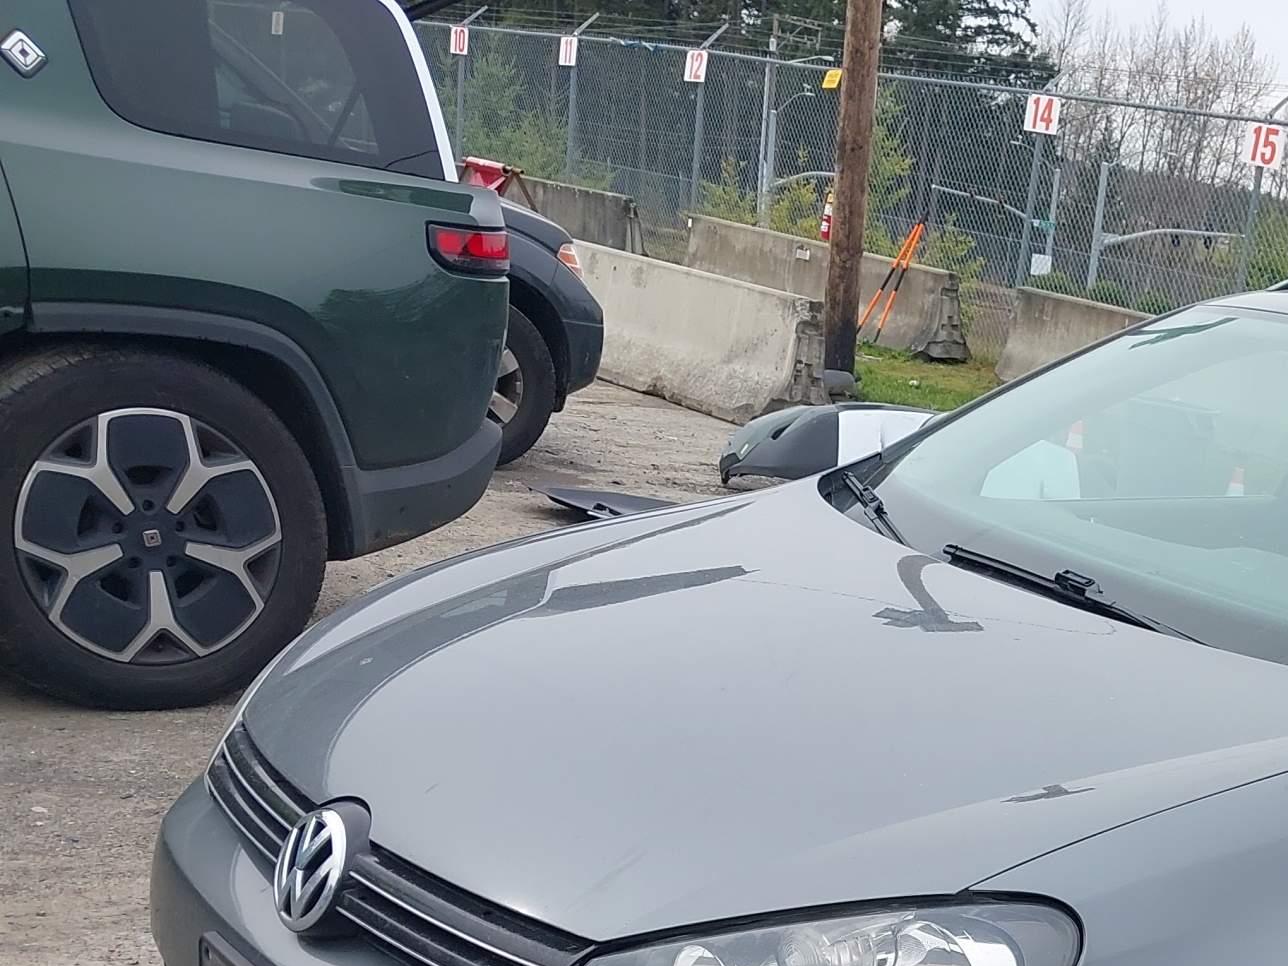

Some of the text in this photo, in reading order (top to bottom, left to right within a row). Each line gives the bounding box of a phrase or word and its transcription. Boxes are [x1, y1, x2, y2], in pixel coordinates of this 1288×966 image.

[453, 28, 466, 53] 10
[564, 38, 575, 64] 11
[688, 52, 703, 80] 12
[1032, 96, 1054, 132] 14
[1250, 125, 1280, 166] 15
